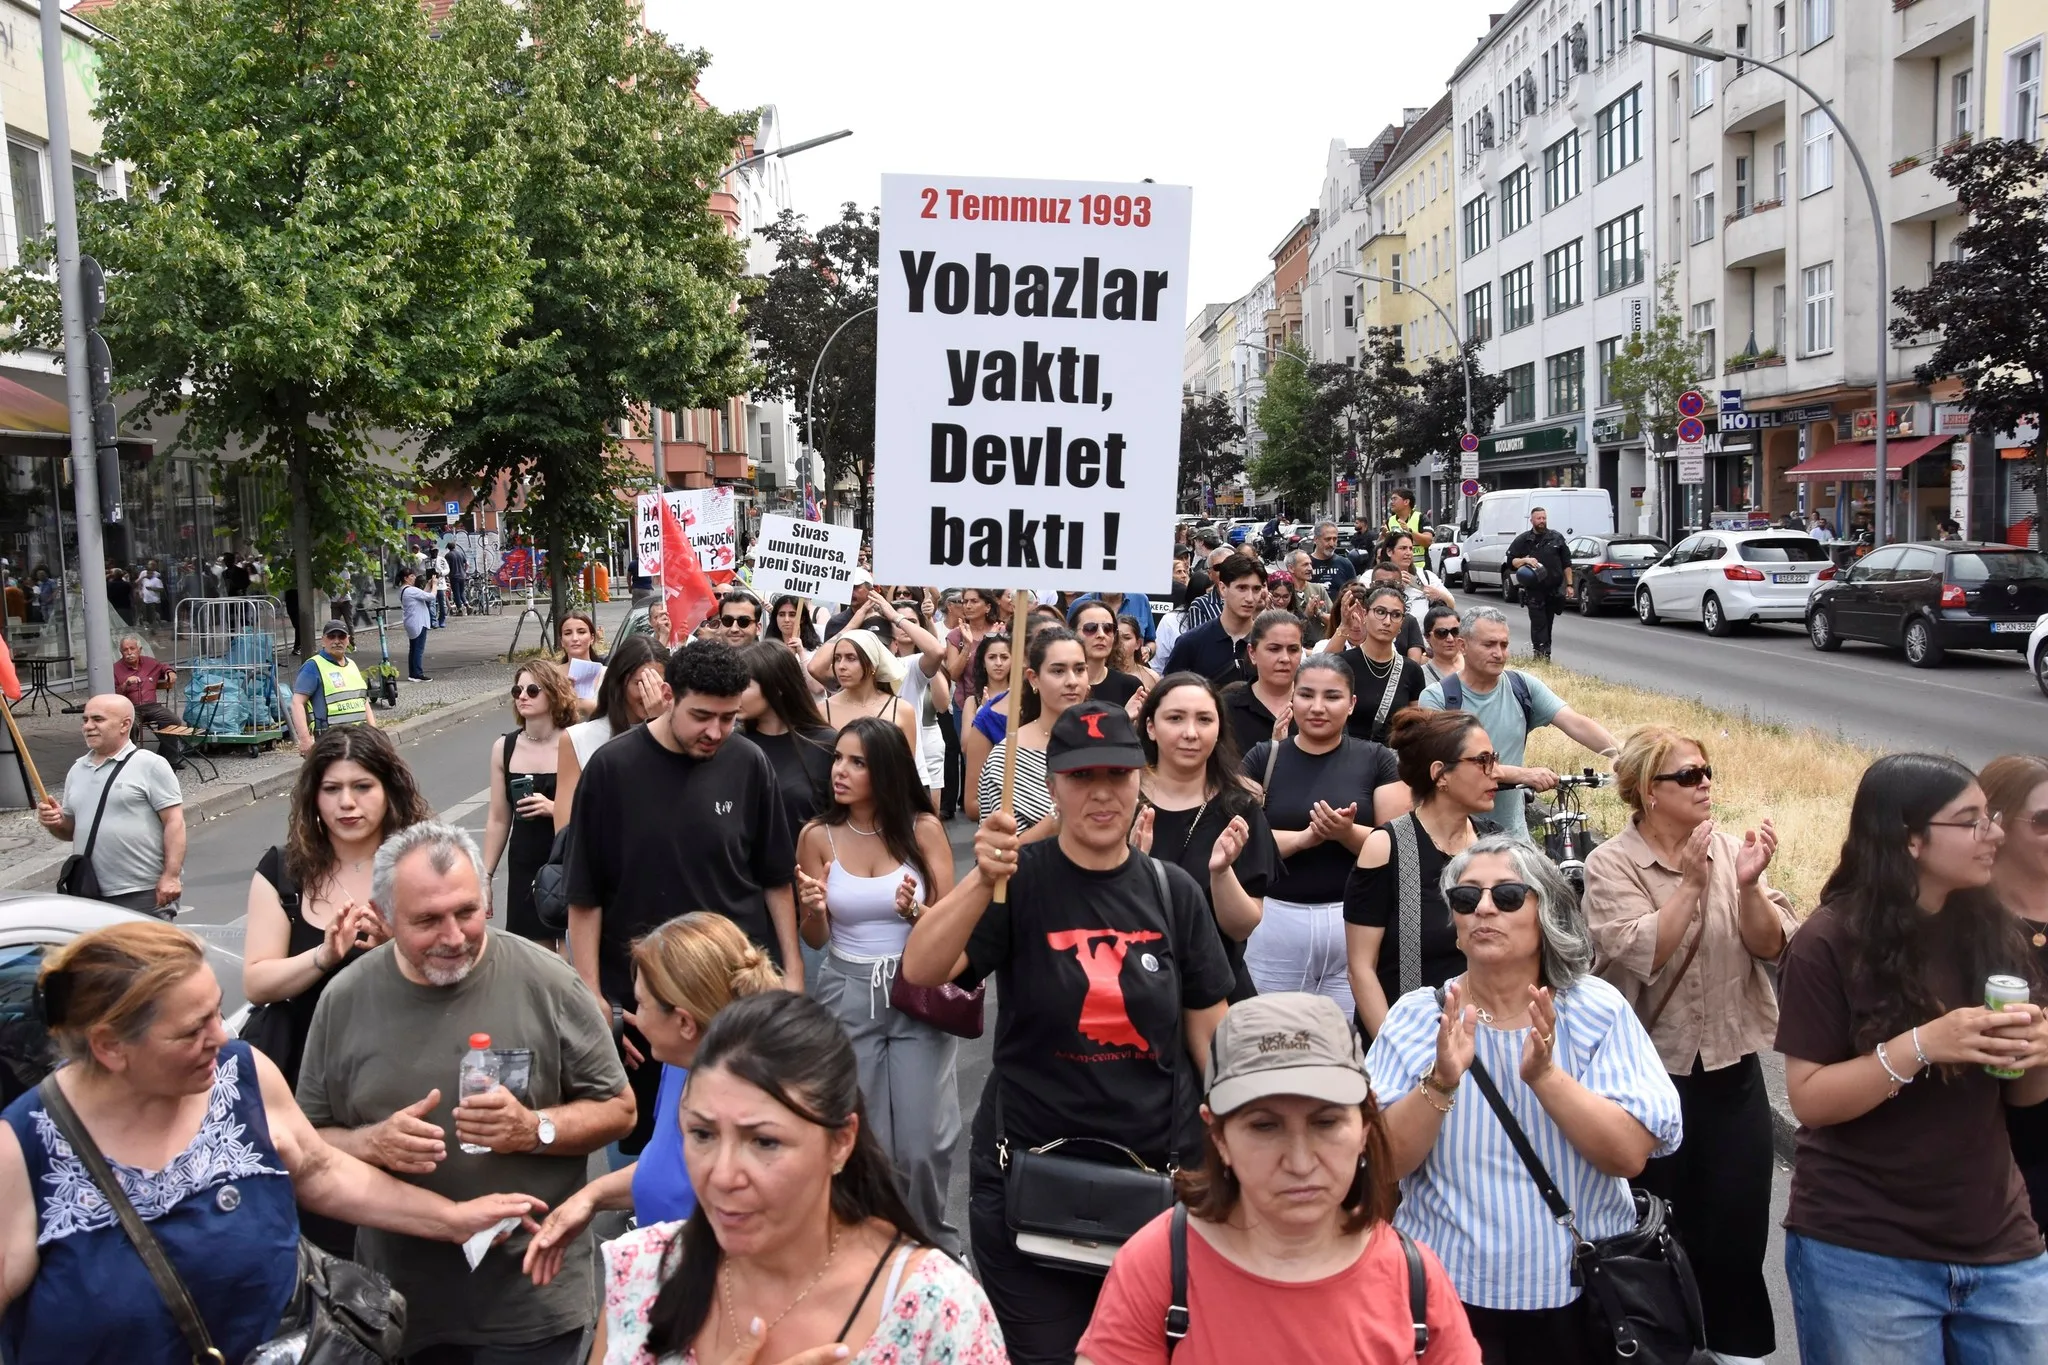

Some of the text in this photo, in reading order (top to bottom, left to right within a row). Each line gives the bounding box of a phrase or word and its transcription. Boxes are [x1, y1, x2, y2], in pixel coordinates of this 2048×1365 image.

[920, 187, 1152, 228] 2 Temmuz 1993
[899, 249, 1169, 322] Yobazlar
[946, 340, 1113, 412] yaktı,
[1721, 412, 1781, 430] HOTEL
[1782, 409, 1808, 422] HOTEL
[1494, 437, 1525, 453] WOOLWORTH
[930, 422, 1127, 489] Devlet
[1798, 428, 1806, 514] HOEL
[448, 503, 455, 513] P
[643, 500, 681, 522] HAGİ
[792, 523, 830, 543] Sivas
[929, 506, 1121, 571] baktı !
[767, 539, 847, 565] unutulursa,
[758, 555, 789, 572] yeni
[784, 577, 820, 594] olur !
[1258, 1041, 1311, 1054] Wolfskin
[1261, 1032, 1286, 1045] Jack
